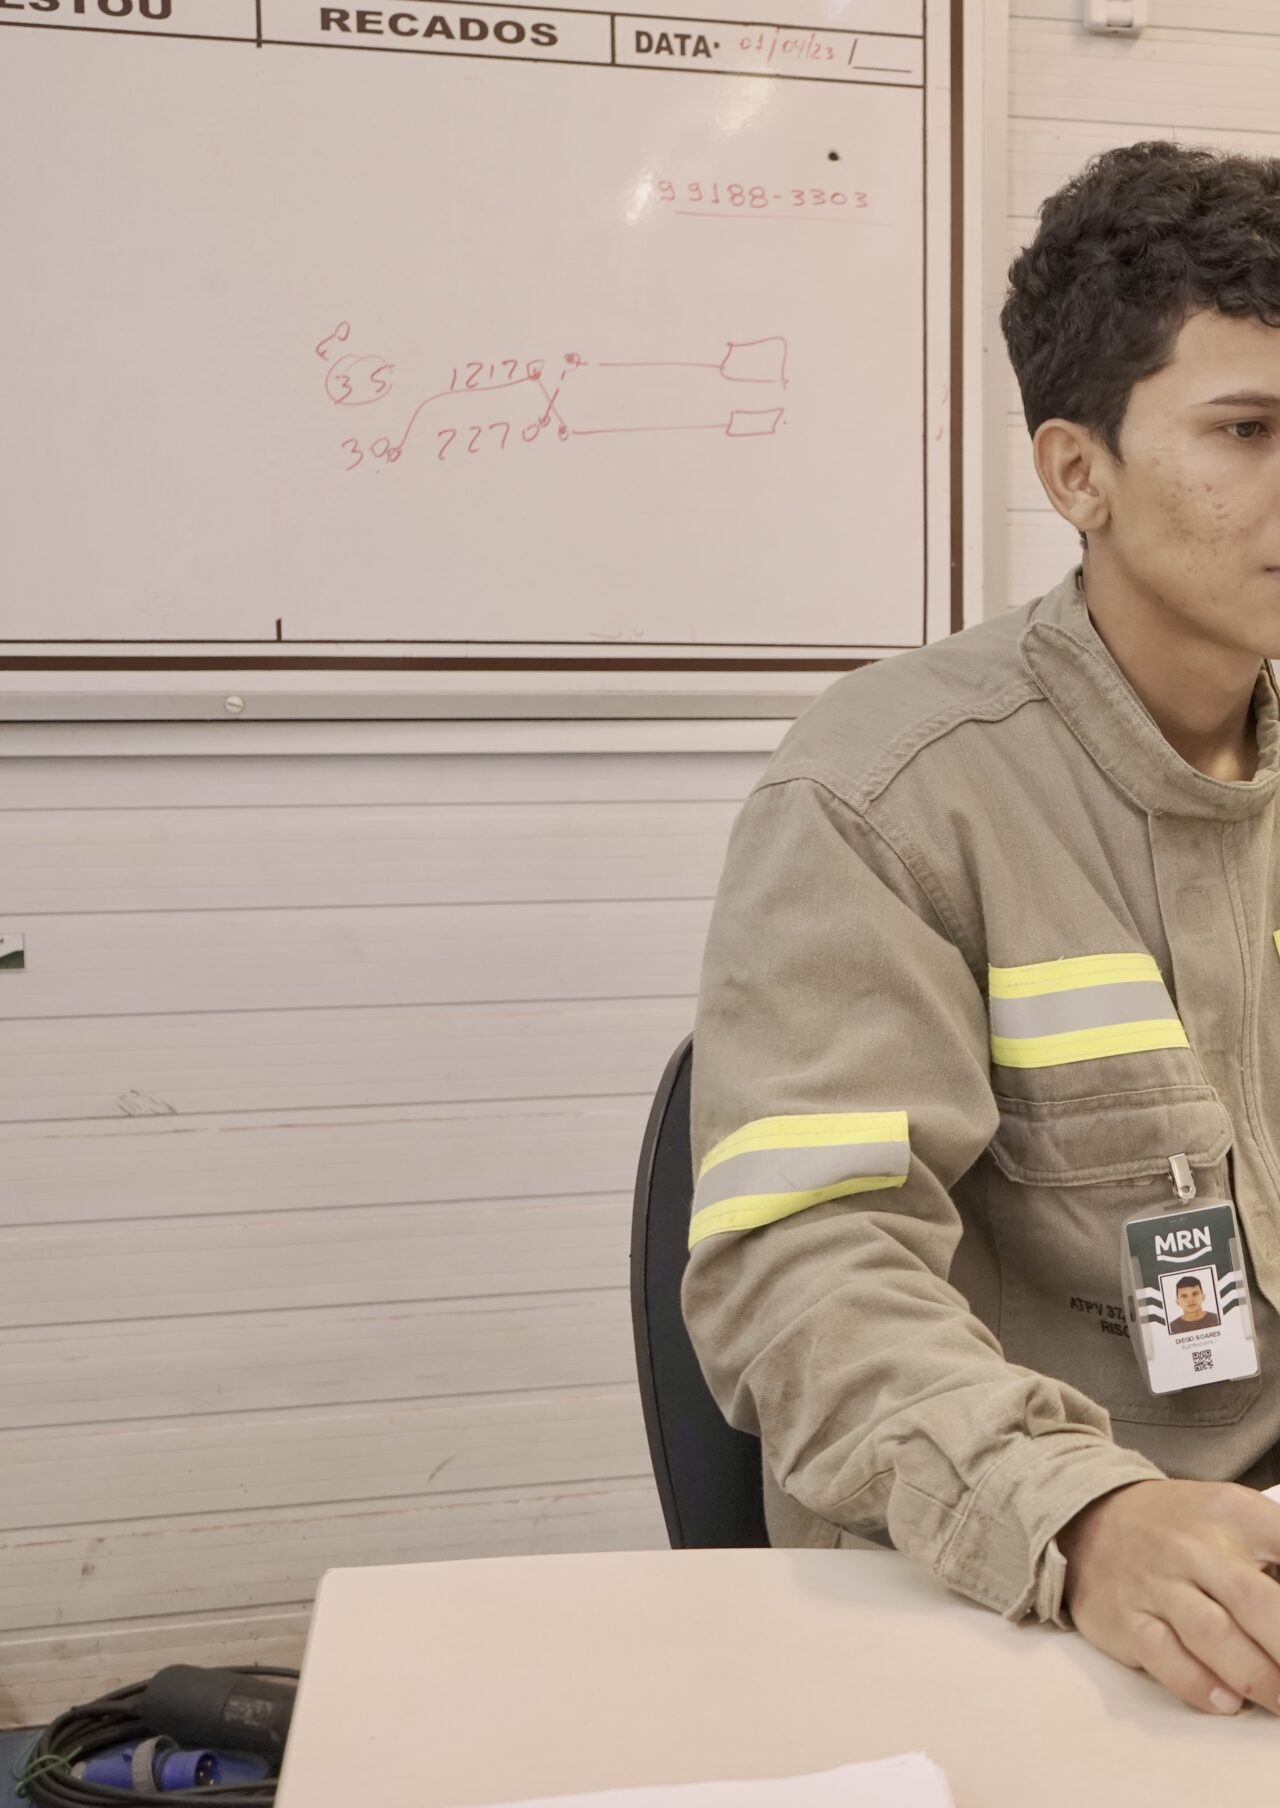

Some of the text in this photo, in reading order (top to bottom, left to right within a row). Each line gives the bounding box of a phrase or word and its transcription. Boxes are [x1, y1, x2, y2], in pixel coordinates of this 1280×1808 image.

[320, 7, 559, 47] RECADOS
[658, 180, 869, 209] 99188-3303
[1154, 1225, 1212, 1256] MRN
[1070, 1296, 1103, 1316] ATPV
[1175, 1330, 1221, 1345] DIEGO SOARES
